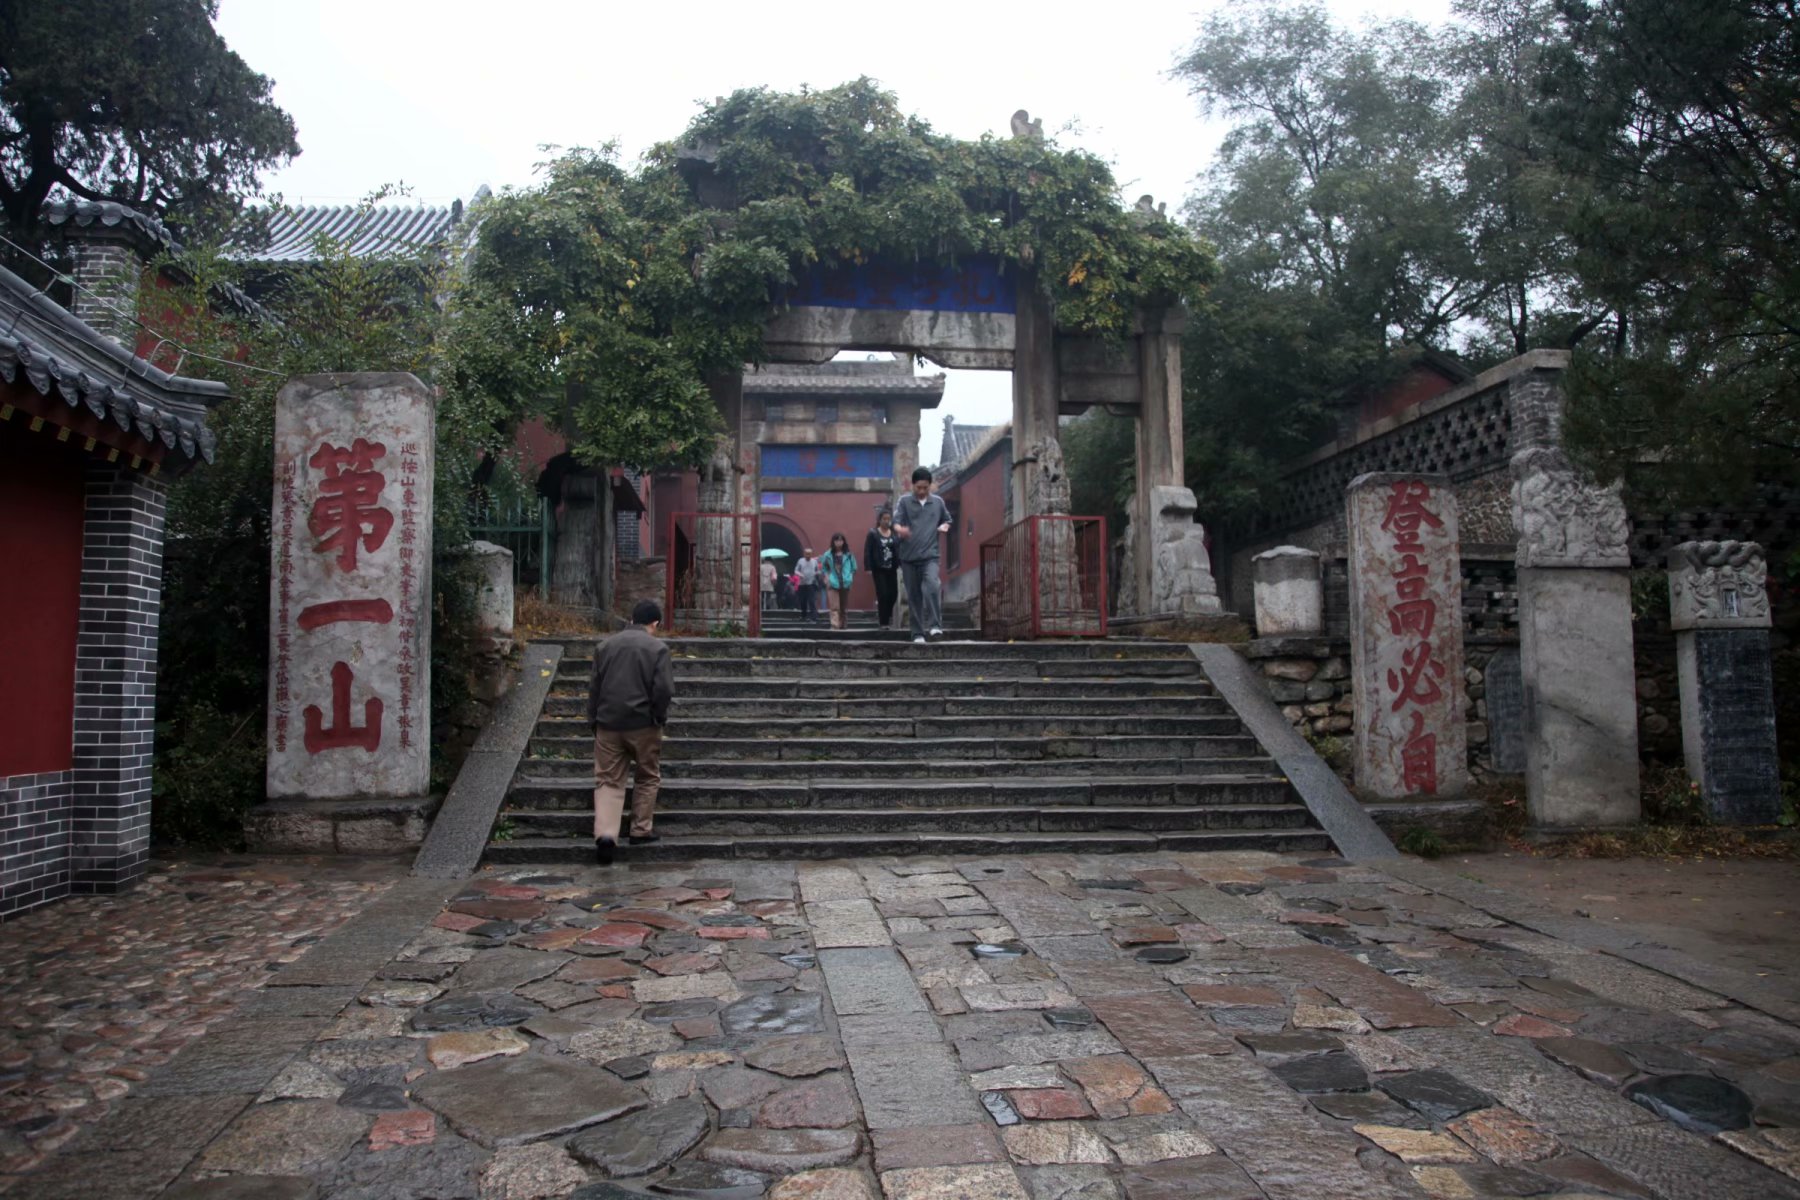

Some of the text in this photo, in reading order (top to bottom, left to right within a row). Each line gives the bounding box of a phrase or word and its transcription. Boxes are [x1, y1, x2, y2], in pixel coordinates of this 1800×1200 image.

[297, 437, 395, 755] 第一山
[1382, 479, 1444, 795] 登高必自
